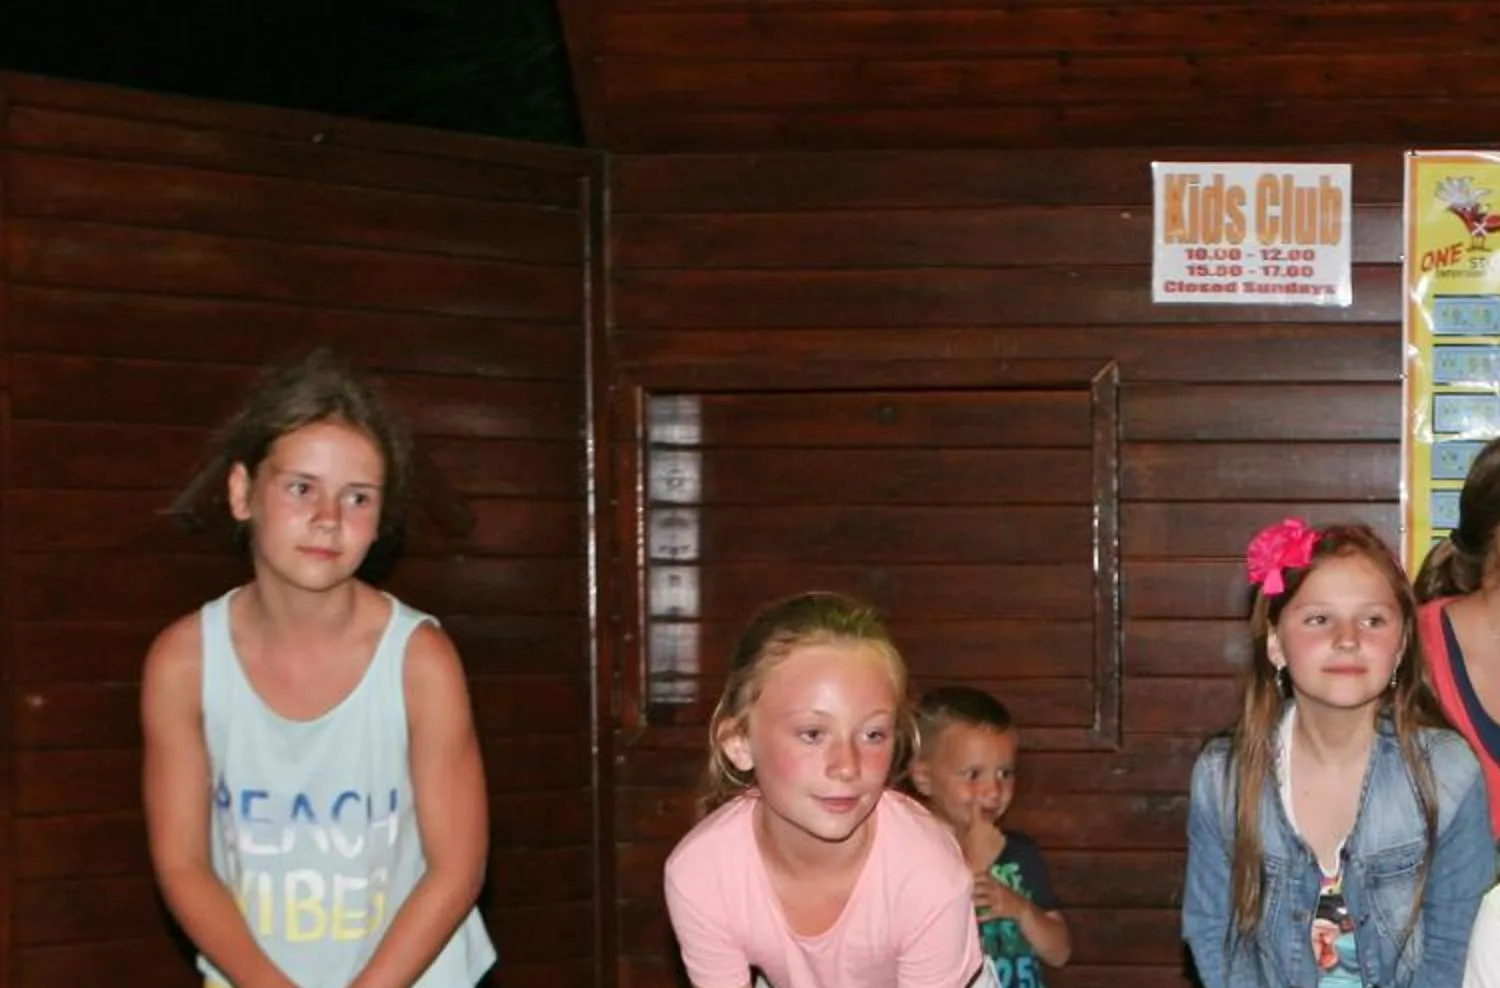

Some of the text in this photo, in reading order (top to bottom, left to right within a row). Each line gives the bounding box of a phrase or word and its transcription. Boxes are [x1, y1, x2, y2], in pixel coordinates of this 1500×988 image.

[1164, 173, 1343, 246] Kids Club
[1421, 243, 1464, 272] ONE
[1164, 281, 1336, 295] Closed Sundays
